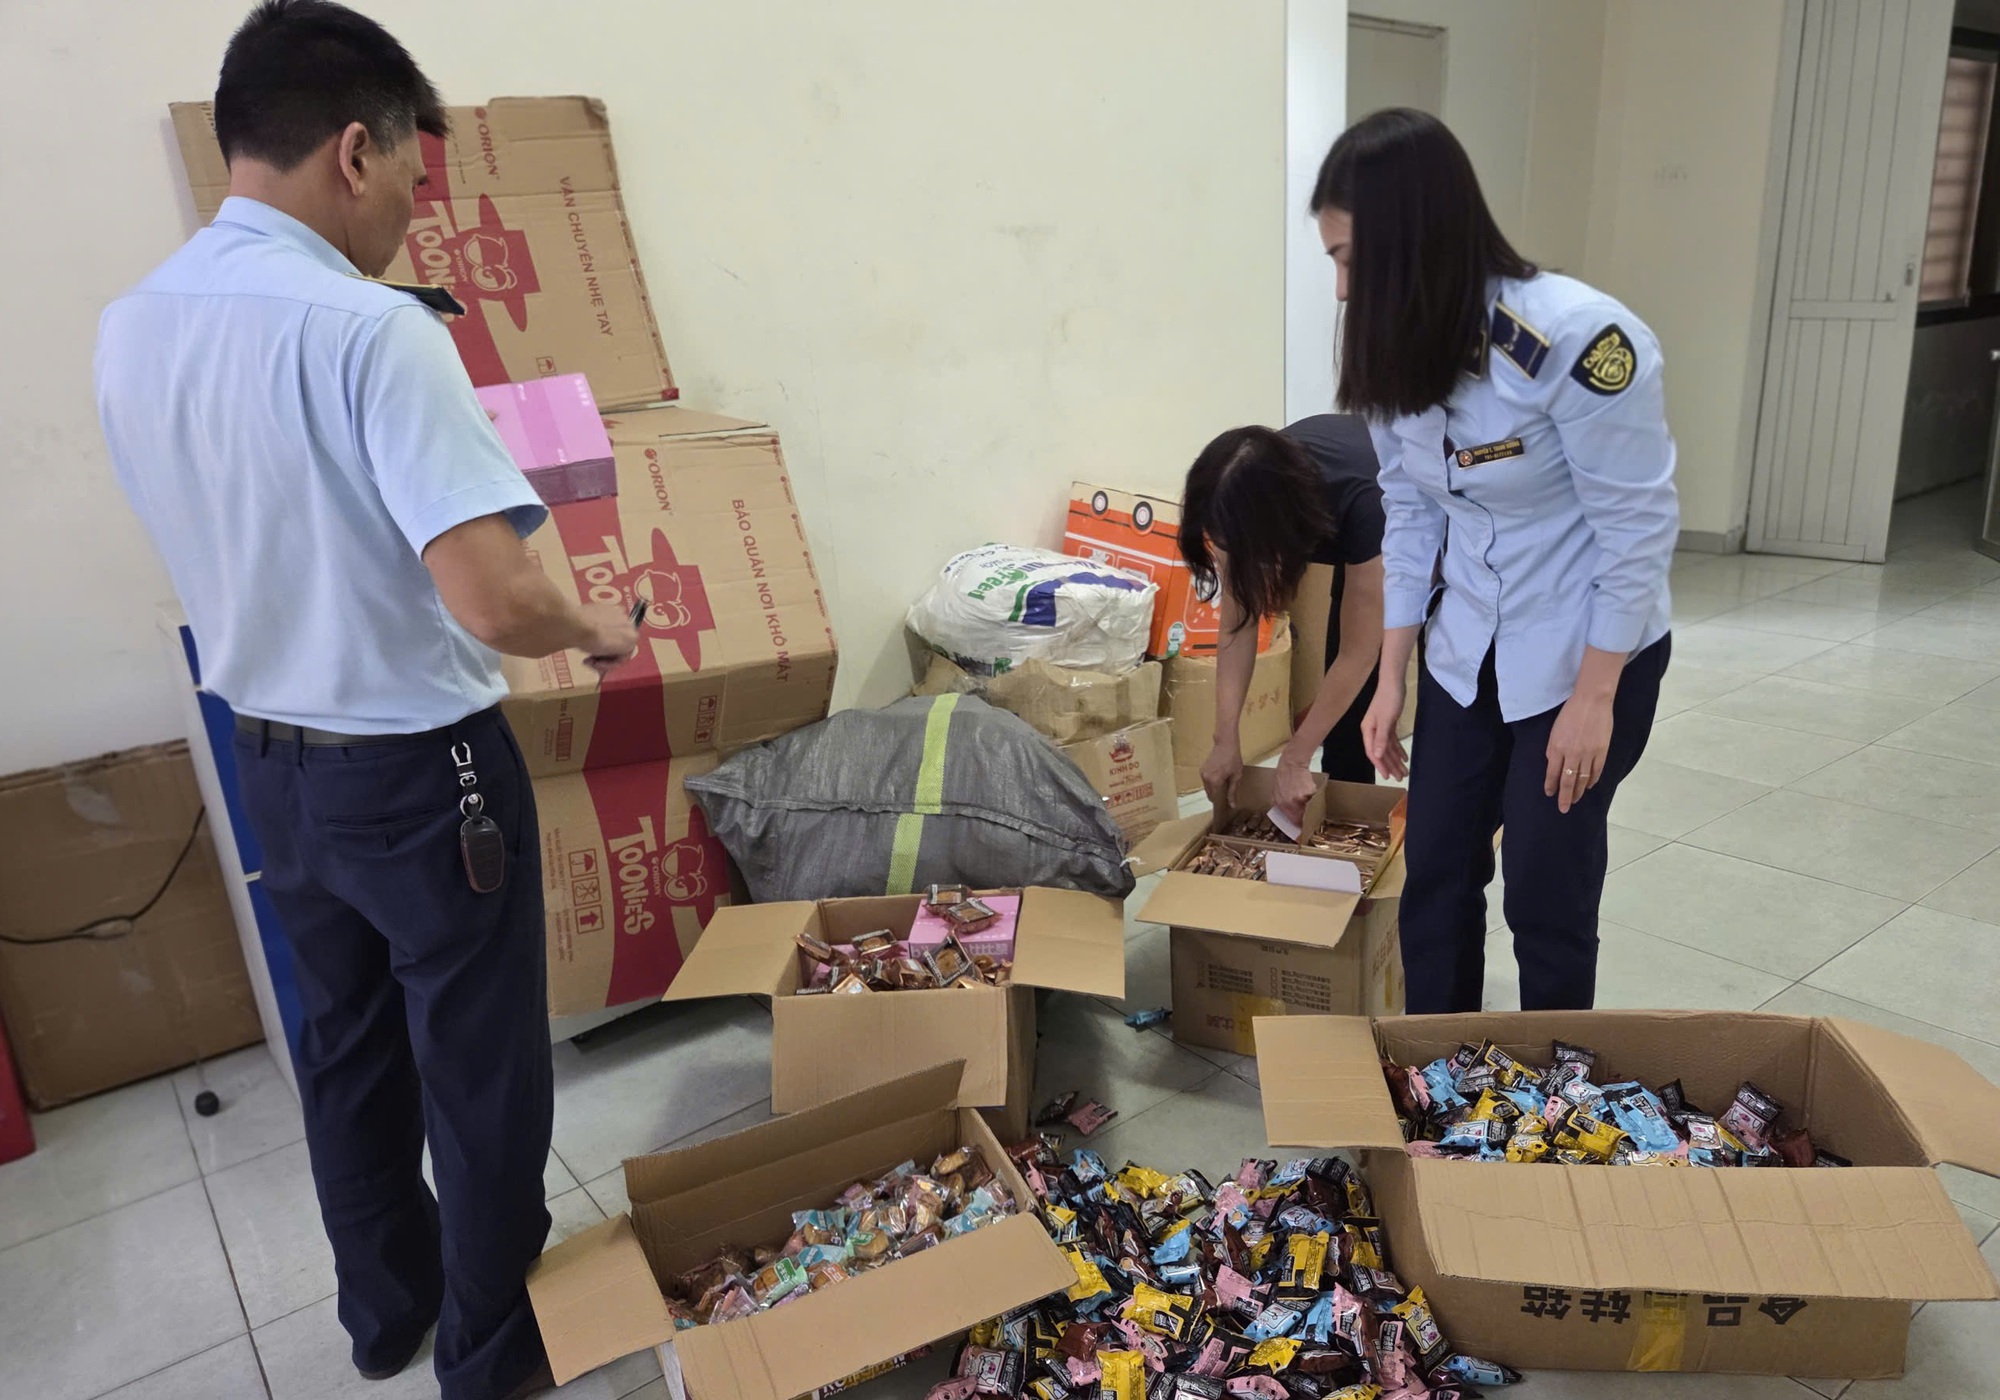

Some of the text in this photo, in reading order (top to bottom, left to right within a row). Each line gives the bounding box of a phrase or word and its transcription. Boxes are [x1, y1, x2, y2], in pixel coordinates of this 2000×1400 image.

[478, 123, 499, 177] ORION
[586, 276, 604, 307] NHẸ
[597, 312, 614, 337] TAY
[648, 462, 673, 511] ORION
[757, 582, 776, 610] NƠI
[766, 614, 788, 647] KHÔ
